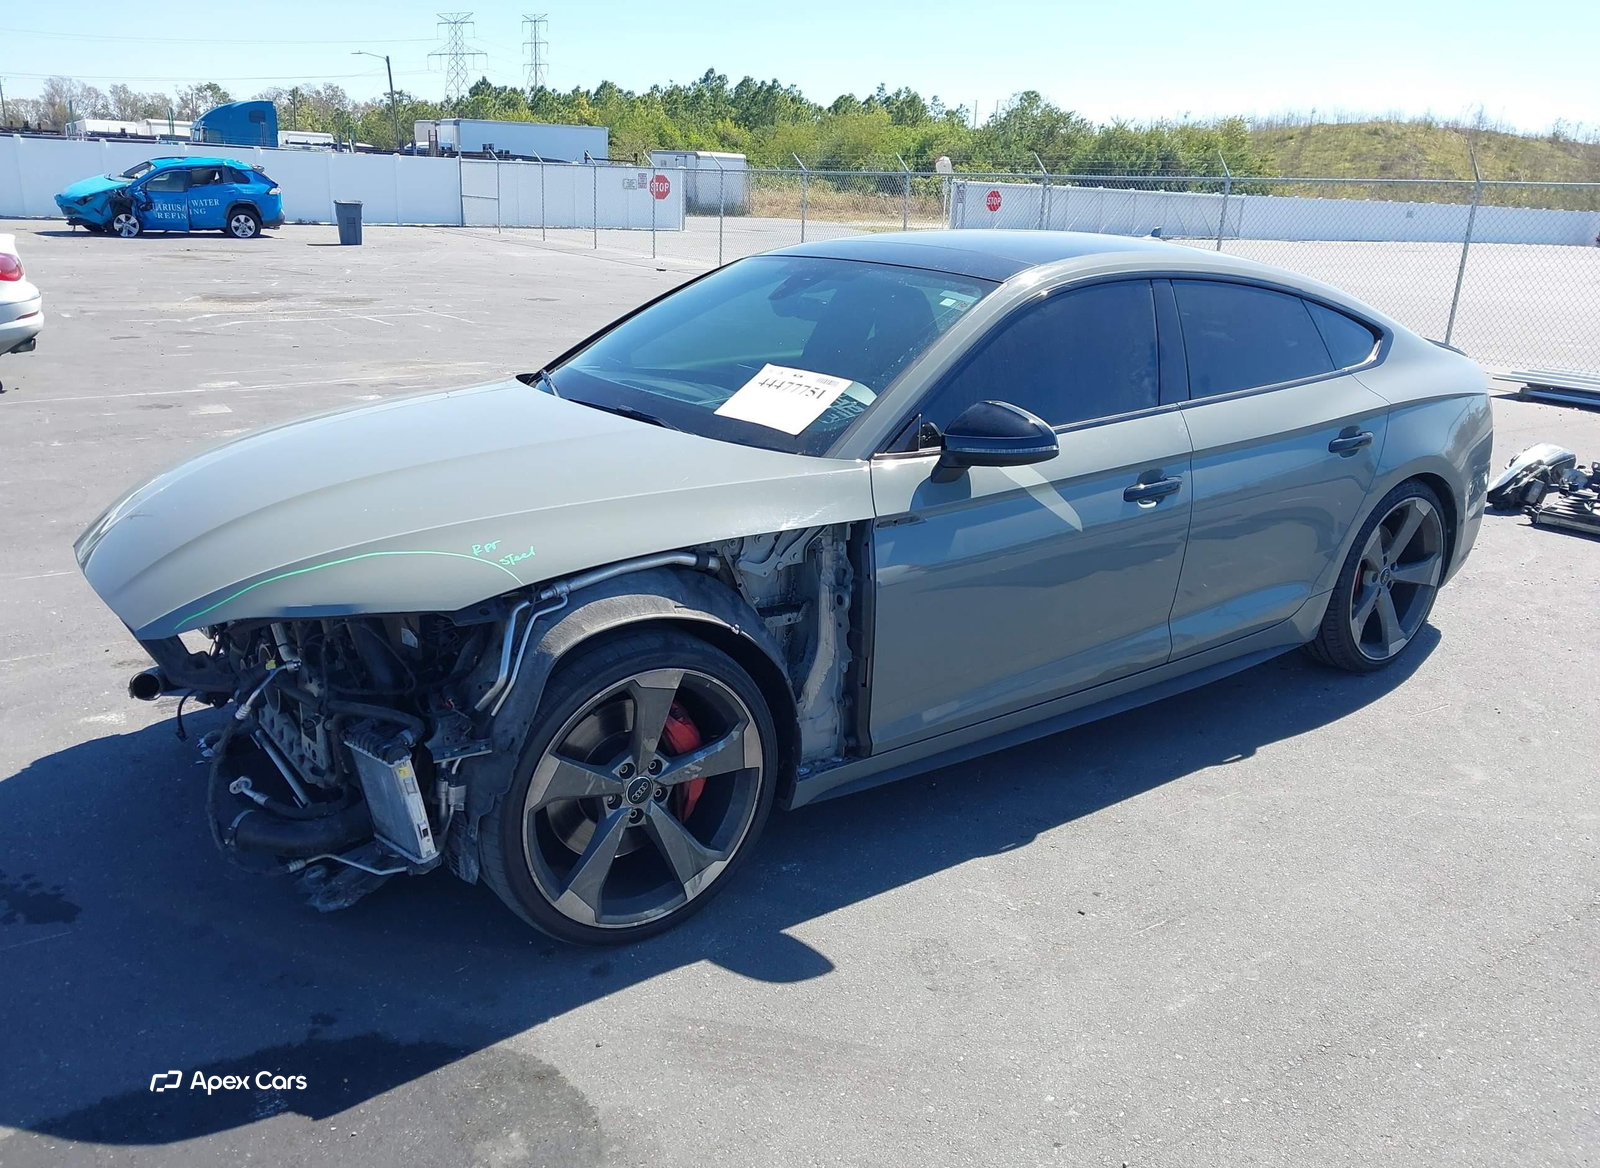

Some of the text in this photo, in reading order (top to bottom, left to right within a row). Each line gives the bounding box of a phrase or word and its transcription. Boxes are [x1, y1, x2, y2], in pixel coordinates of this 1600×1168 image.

[650, 182, 670, 192] STOP
[191, 199, 220, 207] WATER
[987, 196, 1001, 206] STOP
[758, 377, 827, 400] 44477751
